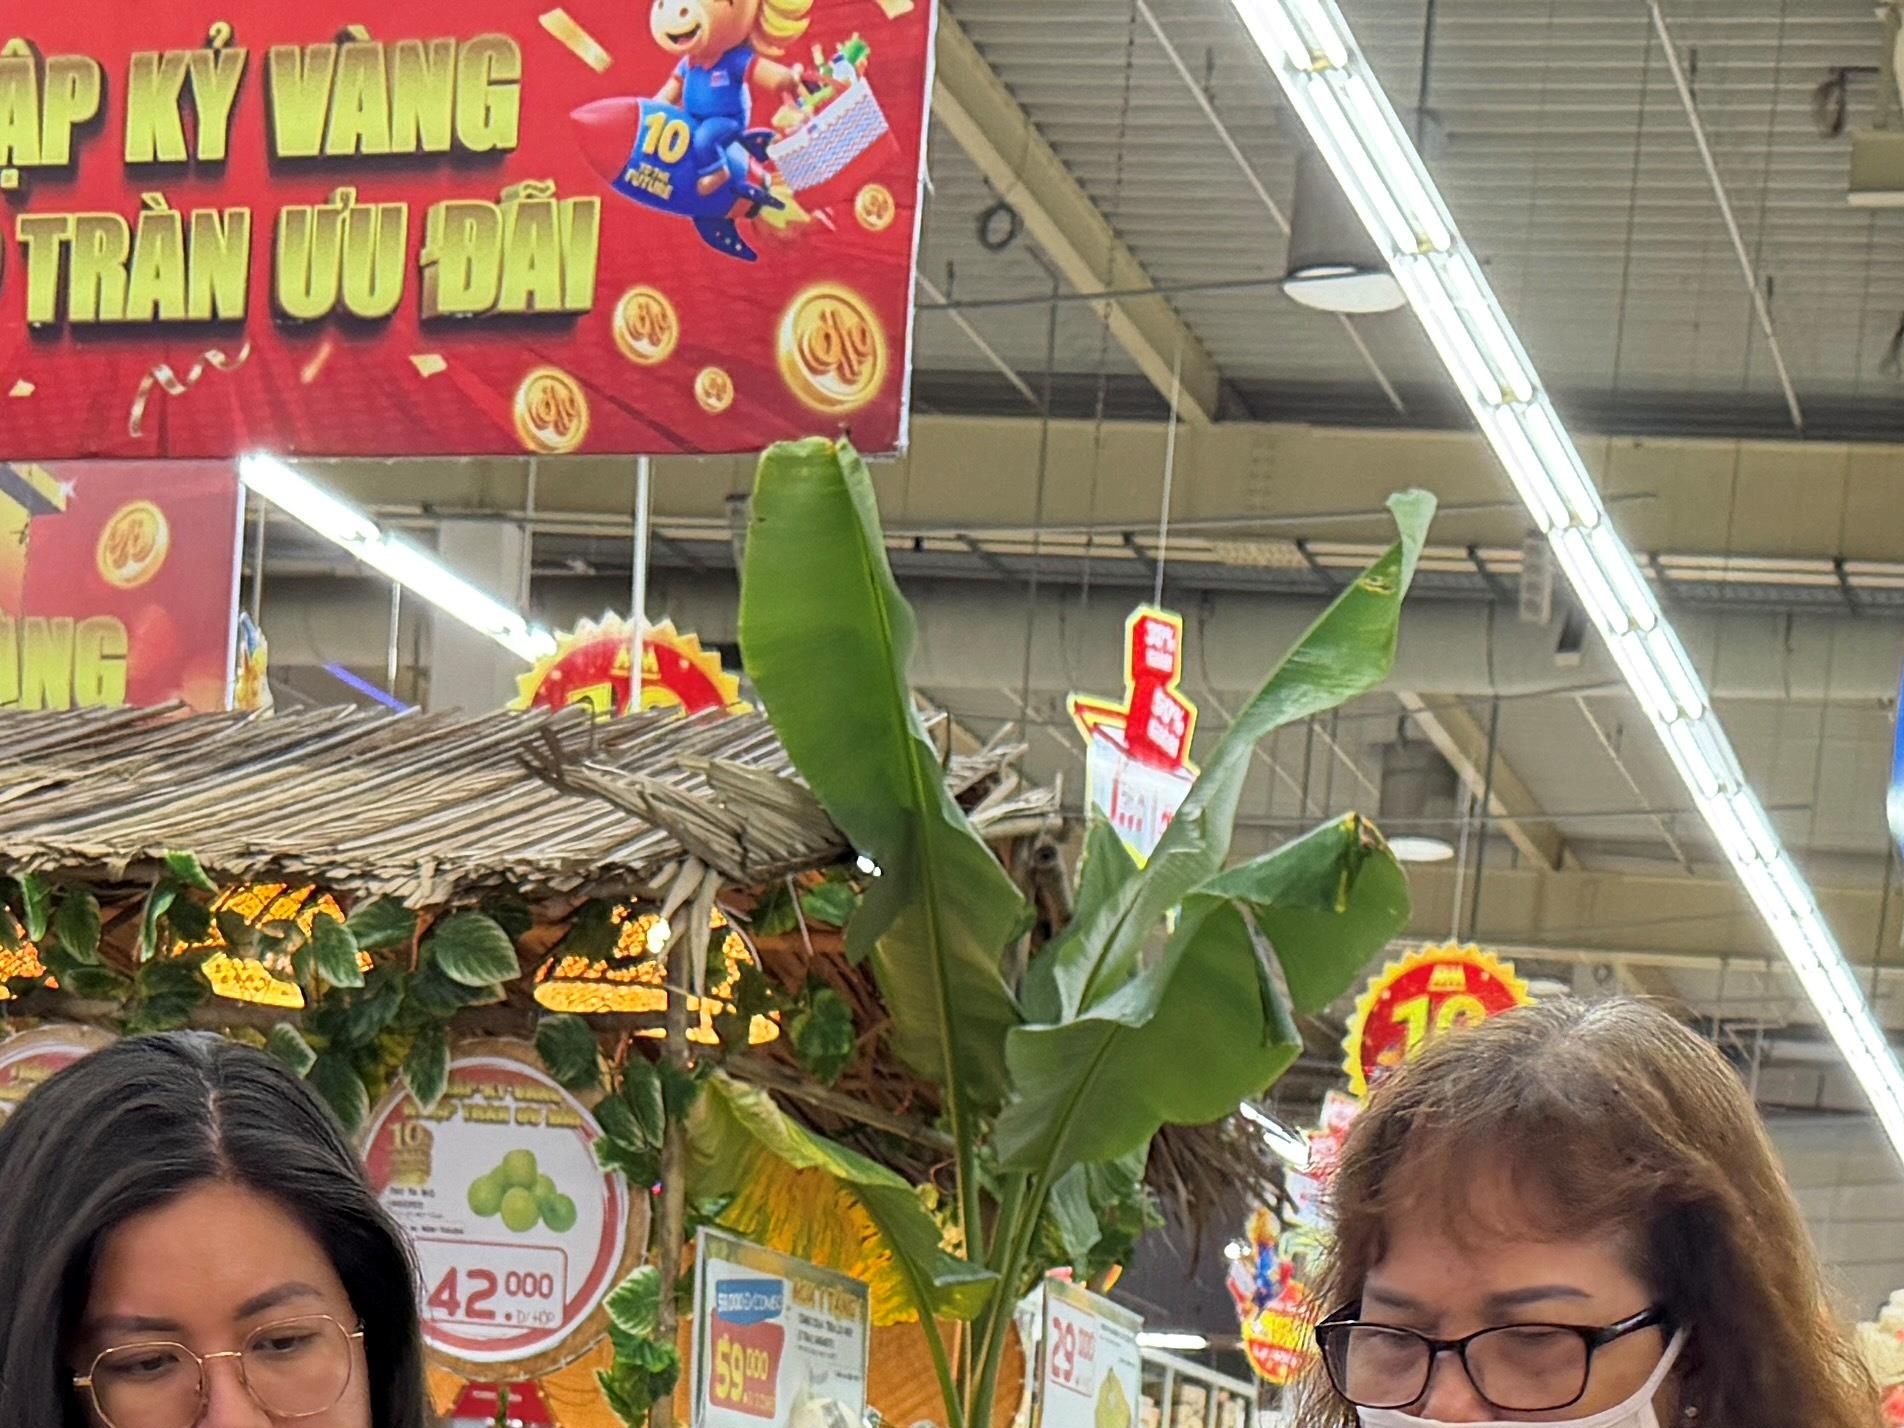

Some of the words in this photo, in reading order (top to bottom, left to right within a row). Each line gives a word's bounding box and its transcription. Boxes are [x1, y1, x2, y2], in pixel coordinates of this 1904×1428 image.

[124, 22, 250, 166] KỶ
[269, 25, 524, 160] VÀNG
[643, 111, 690, 163] 10
[14, 190, 251, 325] TRÀN
[276, 186, 410, 322] ƯU
[419, 178, 602, 318] ĐÃI
[427, 1266, 498, 1321] 42
[505, 1271, 554, 1300] 000
[715, 1333, 744, 1402] 59
[1052, 1316, 1076, 1383] 29
